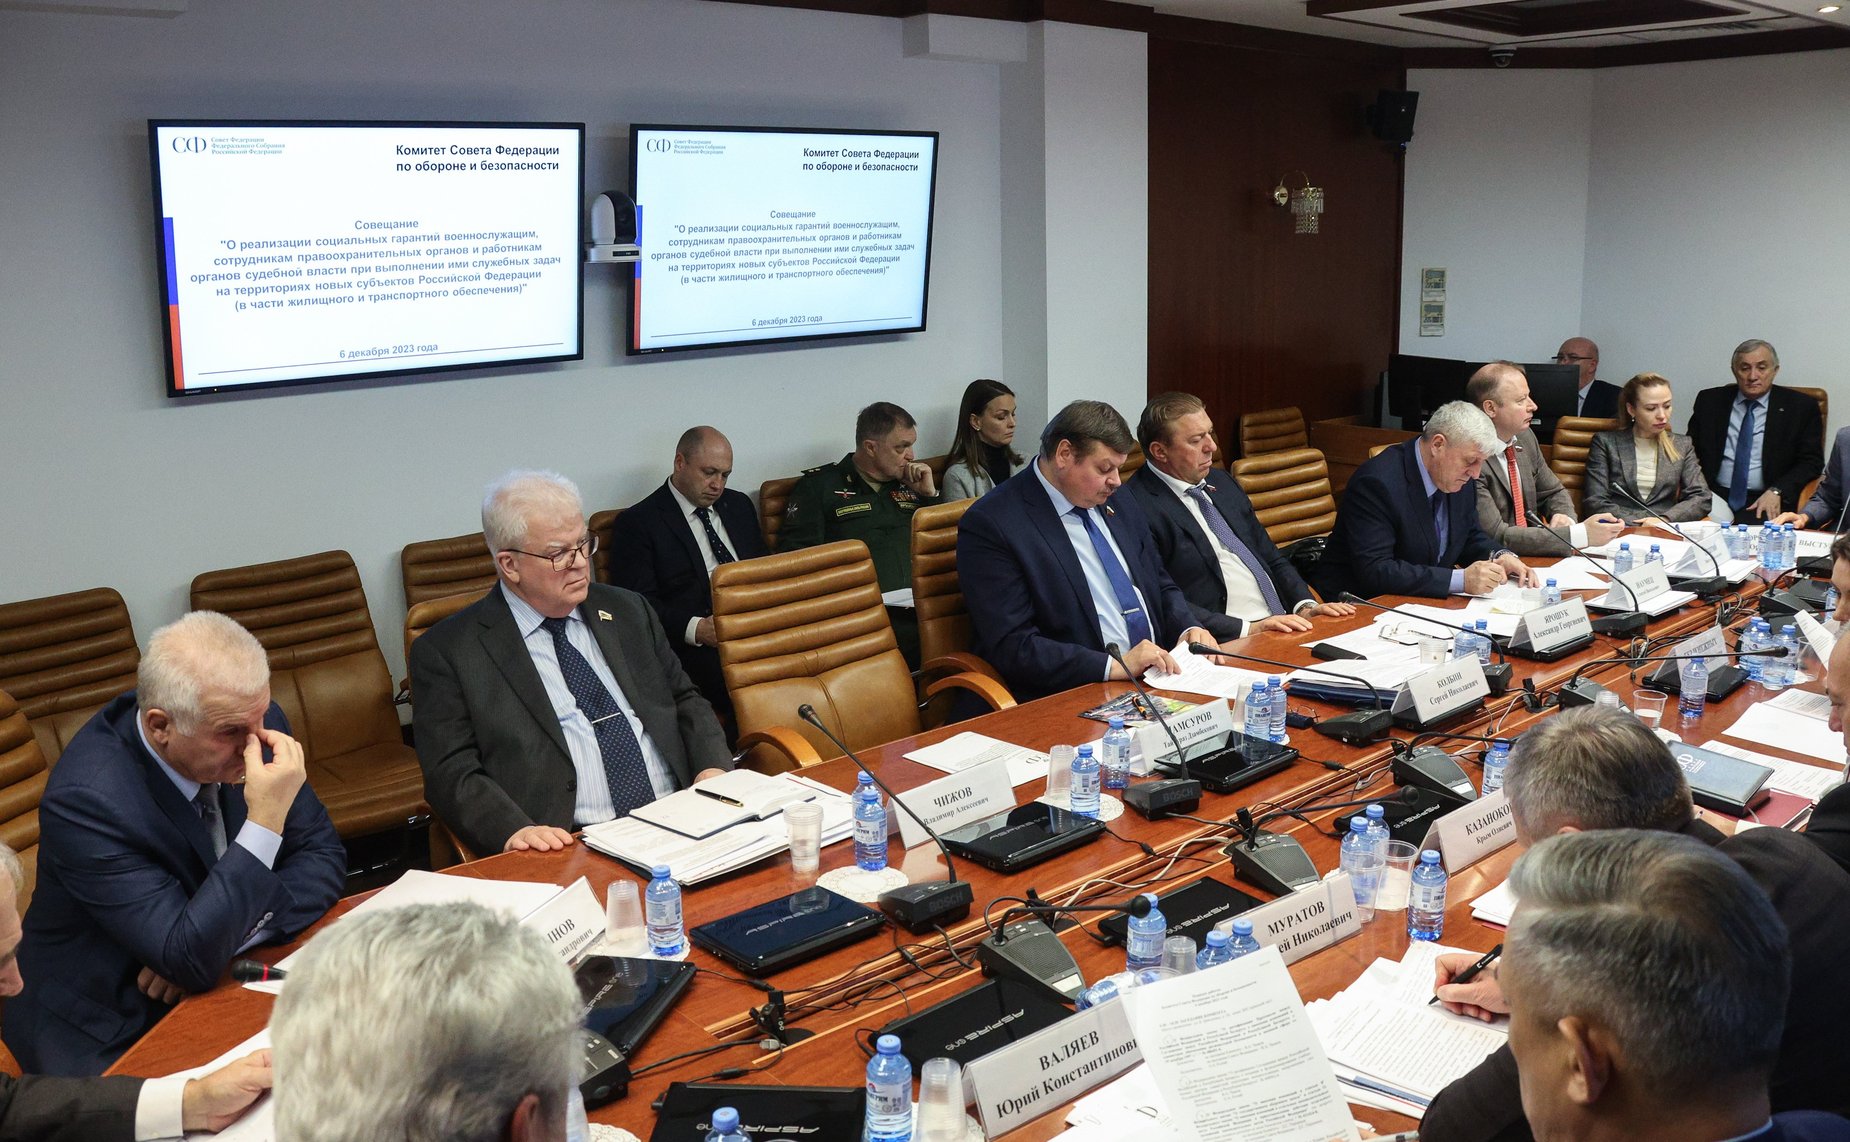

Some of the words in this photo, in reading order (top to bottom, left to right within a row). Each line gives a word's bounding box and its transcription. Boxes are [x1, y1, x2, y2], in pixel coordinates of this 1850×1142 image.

[172, 136, 207, 154] СФ
[396, 144, 446, 156] Комитет
[449, 144, 492, 155] Совета
[494, 144, 559, 157] Федерации
[646, 138, 671, 153] СФ
[803, 147, 839, 157] Комитет
[841, 148, 871, 158] Совета
[873, 149, 919, 160] Федерации
[396, 162, 411, 171] по
[415, 160, 466, 174] обороне
[469, 162, 476, 170] и
[480, 159, 558, 171] безопасности
[802, 162, 813, 170] по
[815, 160, 852, 172] обороне
[862, 161, 918, 172] безопасности
[769, 209, 816, 219] Совещание
[354, 219, 418, 230] Совещание
[687, 225, 739, 235] реализации
[741, 223, 793, 232] социальных
[794, 220, 830, 232] гарантий
[240, 238, 311, 252] реализации
[315, 235, 387, 247] социальных
[391, 232, 440, 245] гарантий
[668, 237, 724, 248] сотрудникам
[727, 234, 816, 246] правоохранительных
[818, 234, 850, 243] органов
[858, 231, 903, 242] работникам
[213, 254, 292, 267] сотрудникам
[297, 248, 421, 264] правоохранительных
[425, 246, 468, 258] органов
[472, 246, 478, 254] и
[481, 243, 542, 256] работникам
[650, 251, 687, 262] органов
[689, 248, 730, 260] судебной
[733, 248, 762, 256] власти
[764, 248, 779, 257] при
[782, 246, 832, 254] выполнении
[833, 245, 849, 253] ими
[850, 242, 893, 254] служебных
[893, 243, 915, 252] задач
[190, 272, 240, 284] органов
[245, 267, 302, 282] судебной
[306, 266, 346, 276] власти
[350, 265, 371, 276] при
[374, 262, 444, 272] выполнении
[447, 260, 468, 269] ими
[471, 256, 529, 270] служебных
[532, 256, 560, 266] задач
[668, 264, 678, 272] на
[680, 262, 736, 273] территориях
[738, 260, 765, 268] новых
[767, 258, 809, 269] субъектов
[812, 255, 857, 265] Российской
[858, 255, 902, 264] Федерации
[216, 287, 230, 296] на
[233, 283, 310, 297] территориях
[315, 281, 352, 290] новых
[356, 277, 414, 290] субъектов
[418, 272, 480, 284] Российской
[484, 270, 541, 281] Федерации
[691, 275, 715, 283] части
[717, 272, 766, 282] жилищного
[775, 269, 833, 280] транспортного
[250, 299, 283, 309] части
[287, 295, 354, 307] жилищного
[357, 294, 364, 302] и
[367, 289, 449, 304] транспортного
[751, 318, 756, 326] 6
[757, 316, 788, 327] декабря
[788, 314, 806, 326] 2023
[806, 315, 823, 325] года
[339, 349, 345, 358] 6
[347, 346, 389, 359] декабря
[392, 344, 414, 357] 2023
[416, 343, 438, 355] года
[1533, 625, 1560, 640] Александр
[1436, 671, 1463, 689] КОЛБИН
[1429, 692, 1448, 705] Сергей
[1448, 680, 1479, 697] Николаевич
[933, 786, 973, 808] ЧИЖОВ
[923, 808, 954, 826] Владимир
[955, 796, 989, 816] Алексеевич
[1475, 832, 1491, 845] Крым
[1267, 900, 1325, 937] МУРАТОВ
[1292, 911, 1353, 948] Николаевич
[560, 928, 594, 957] андрович
[583, 984, 614, 1015] SPIRE
[964, 1008, 1025, 1041] ASPIRE
[1039, 1030, 1100, 1072] ВАЛЯЕВ
[996, 1086, 1041, 1119] Юрий
